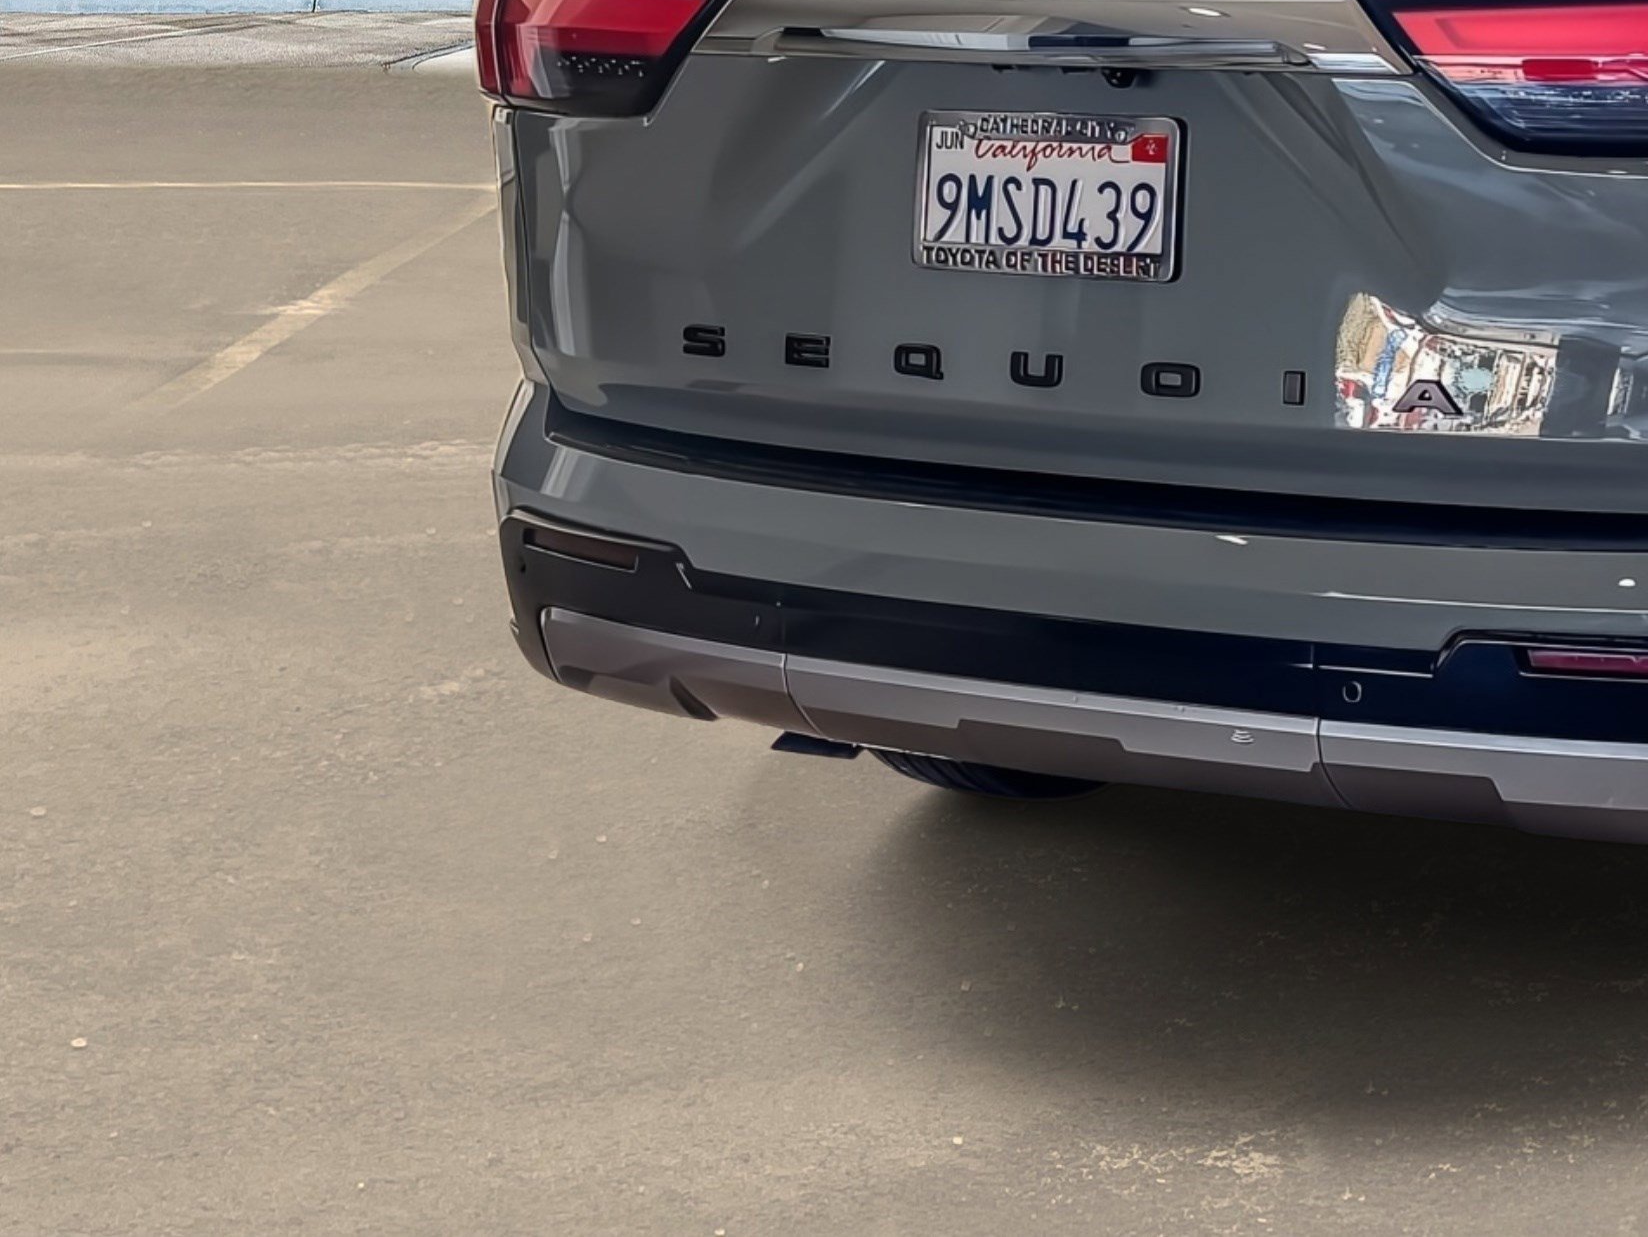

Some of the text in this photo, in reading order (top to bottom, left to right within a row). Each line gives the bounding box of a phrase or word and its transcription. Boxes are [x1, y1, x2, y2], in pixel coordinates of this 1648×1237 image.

[935, 129, 965, 150] JUN
[974, 136, 1131, 172] California
[933, 172, 1158, 252] 9MSD439
[922, 245, 998, 269] TOYOTA
[1004, 250, 1033, 272] OF
[1038, 252, 1076, 275] THE
[680, 323, 1465, 417] SEQUOIA
